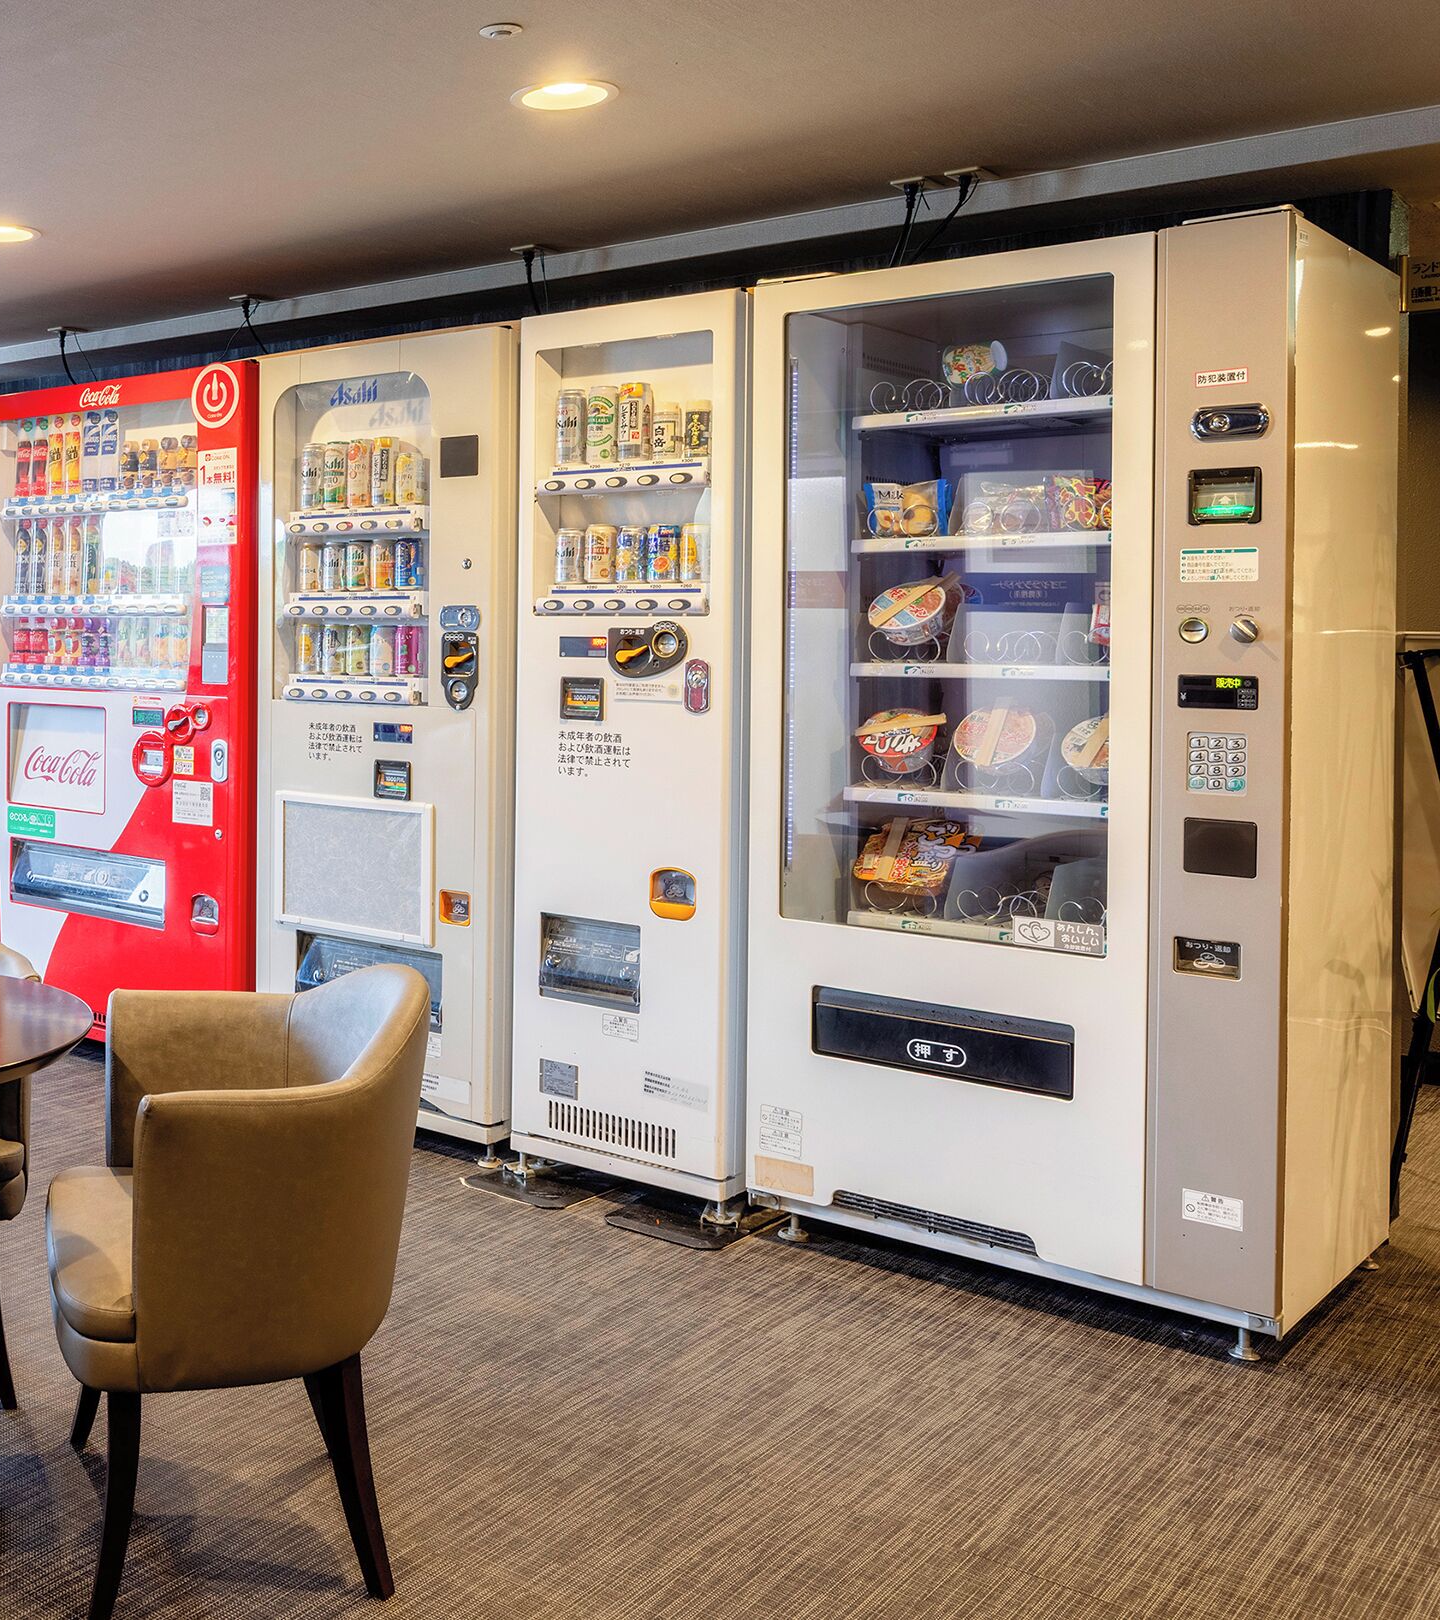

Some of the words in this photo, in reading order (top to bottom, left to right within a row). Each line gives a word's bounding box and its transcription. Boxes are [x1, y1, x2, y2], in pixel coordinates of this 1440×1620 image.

[1197, 370, 1246, 385] 防犯装置付
[79, 383, 122, 408] Coca-Cola
[329, 378, 379, 407] Asahi
[556, 416, 578, 430] sahi
[878, 490, 905, 500] Milk
[1215, 677, 1242, 688] 販売中
[308, 722, 356, 733] 未成年者の飲酒
[308, 732, 363, 744] および飲酒運転は
[558, 730, 622, 744] 未成年者の飲酒
[308, 742, 363, 754] 法律で禁止されて
[558, 742, 631, 756] および飲酒運転は
[1213, 739, 1222, 747] 2
[1231, 740, 1240, 748] 3
[308, 752, 332, 761] います。
[557, 753, 631, 768] 法律で禁止されて
[24, 745, 103, 787] Coca-Cola
[558, 766, 588, 778] います。
[1195, 765, 1202, 773] 7
[1212, 766, 1221, 774] 8
[1231, 767, 1240, 775] 9
[1212, 780, 1221, 788] 0
[1056, 922, 1100, 937] あんしん、
[1061, 934, 1100, 946] おいしい
[1184, 941, 1232, 954] おつり・返却
[913, 1041, 959, 1064] 押す
